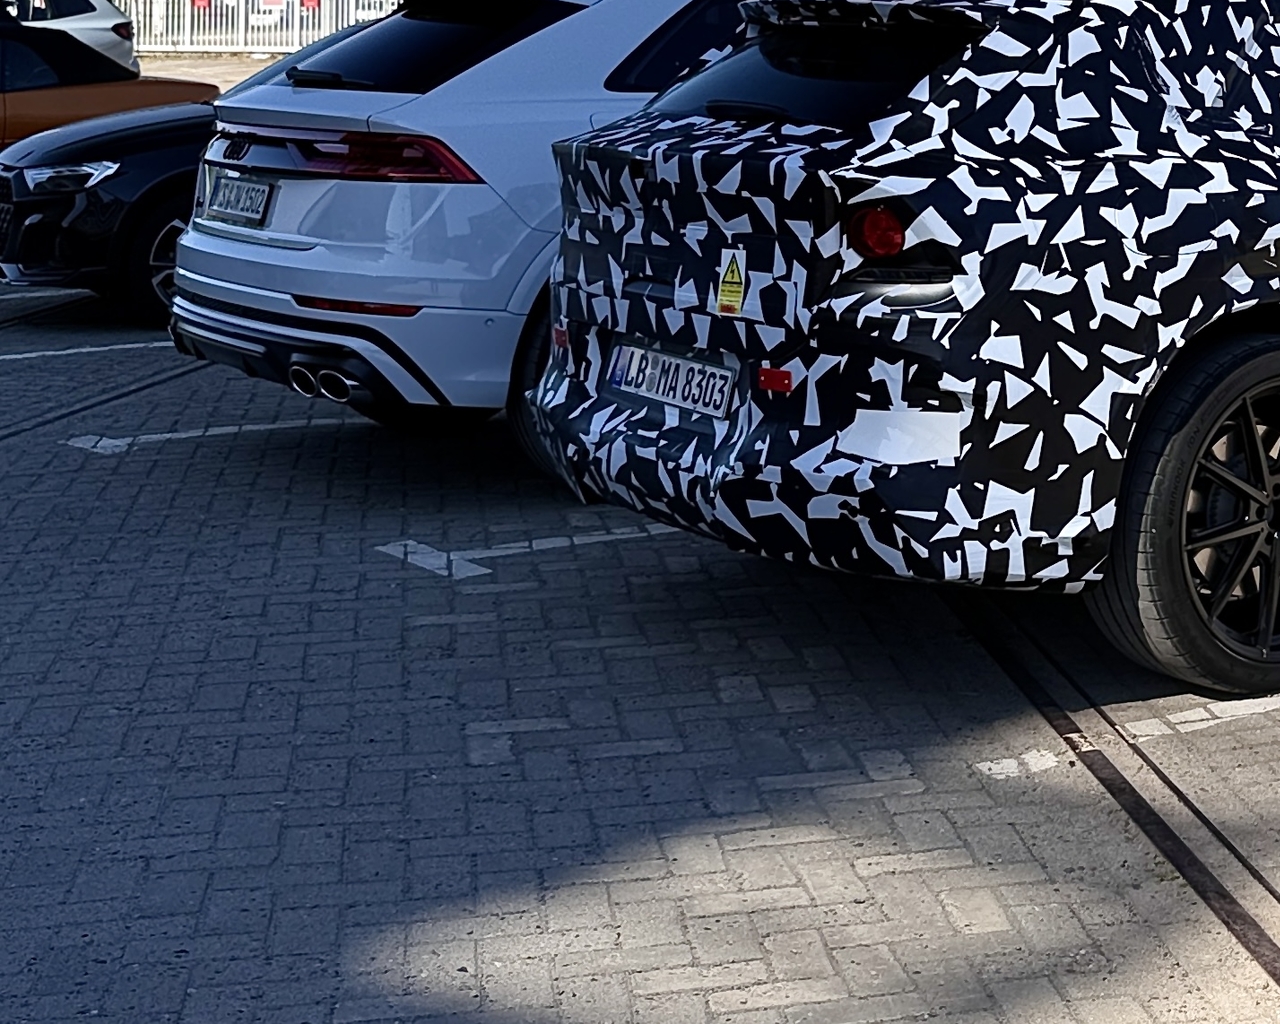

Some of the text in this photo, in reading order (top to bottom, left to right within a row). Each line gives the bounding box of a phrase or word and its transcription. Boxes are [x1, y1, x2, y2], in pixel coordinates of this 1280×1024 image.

[624, 351, 730, 411] LB MA 8303
